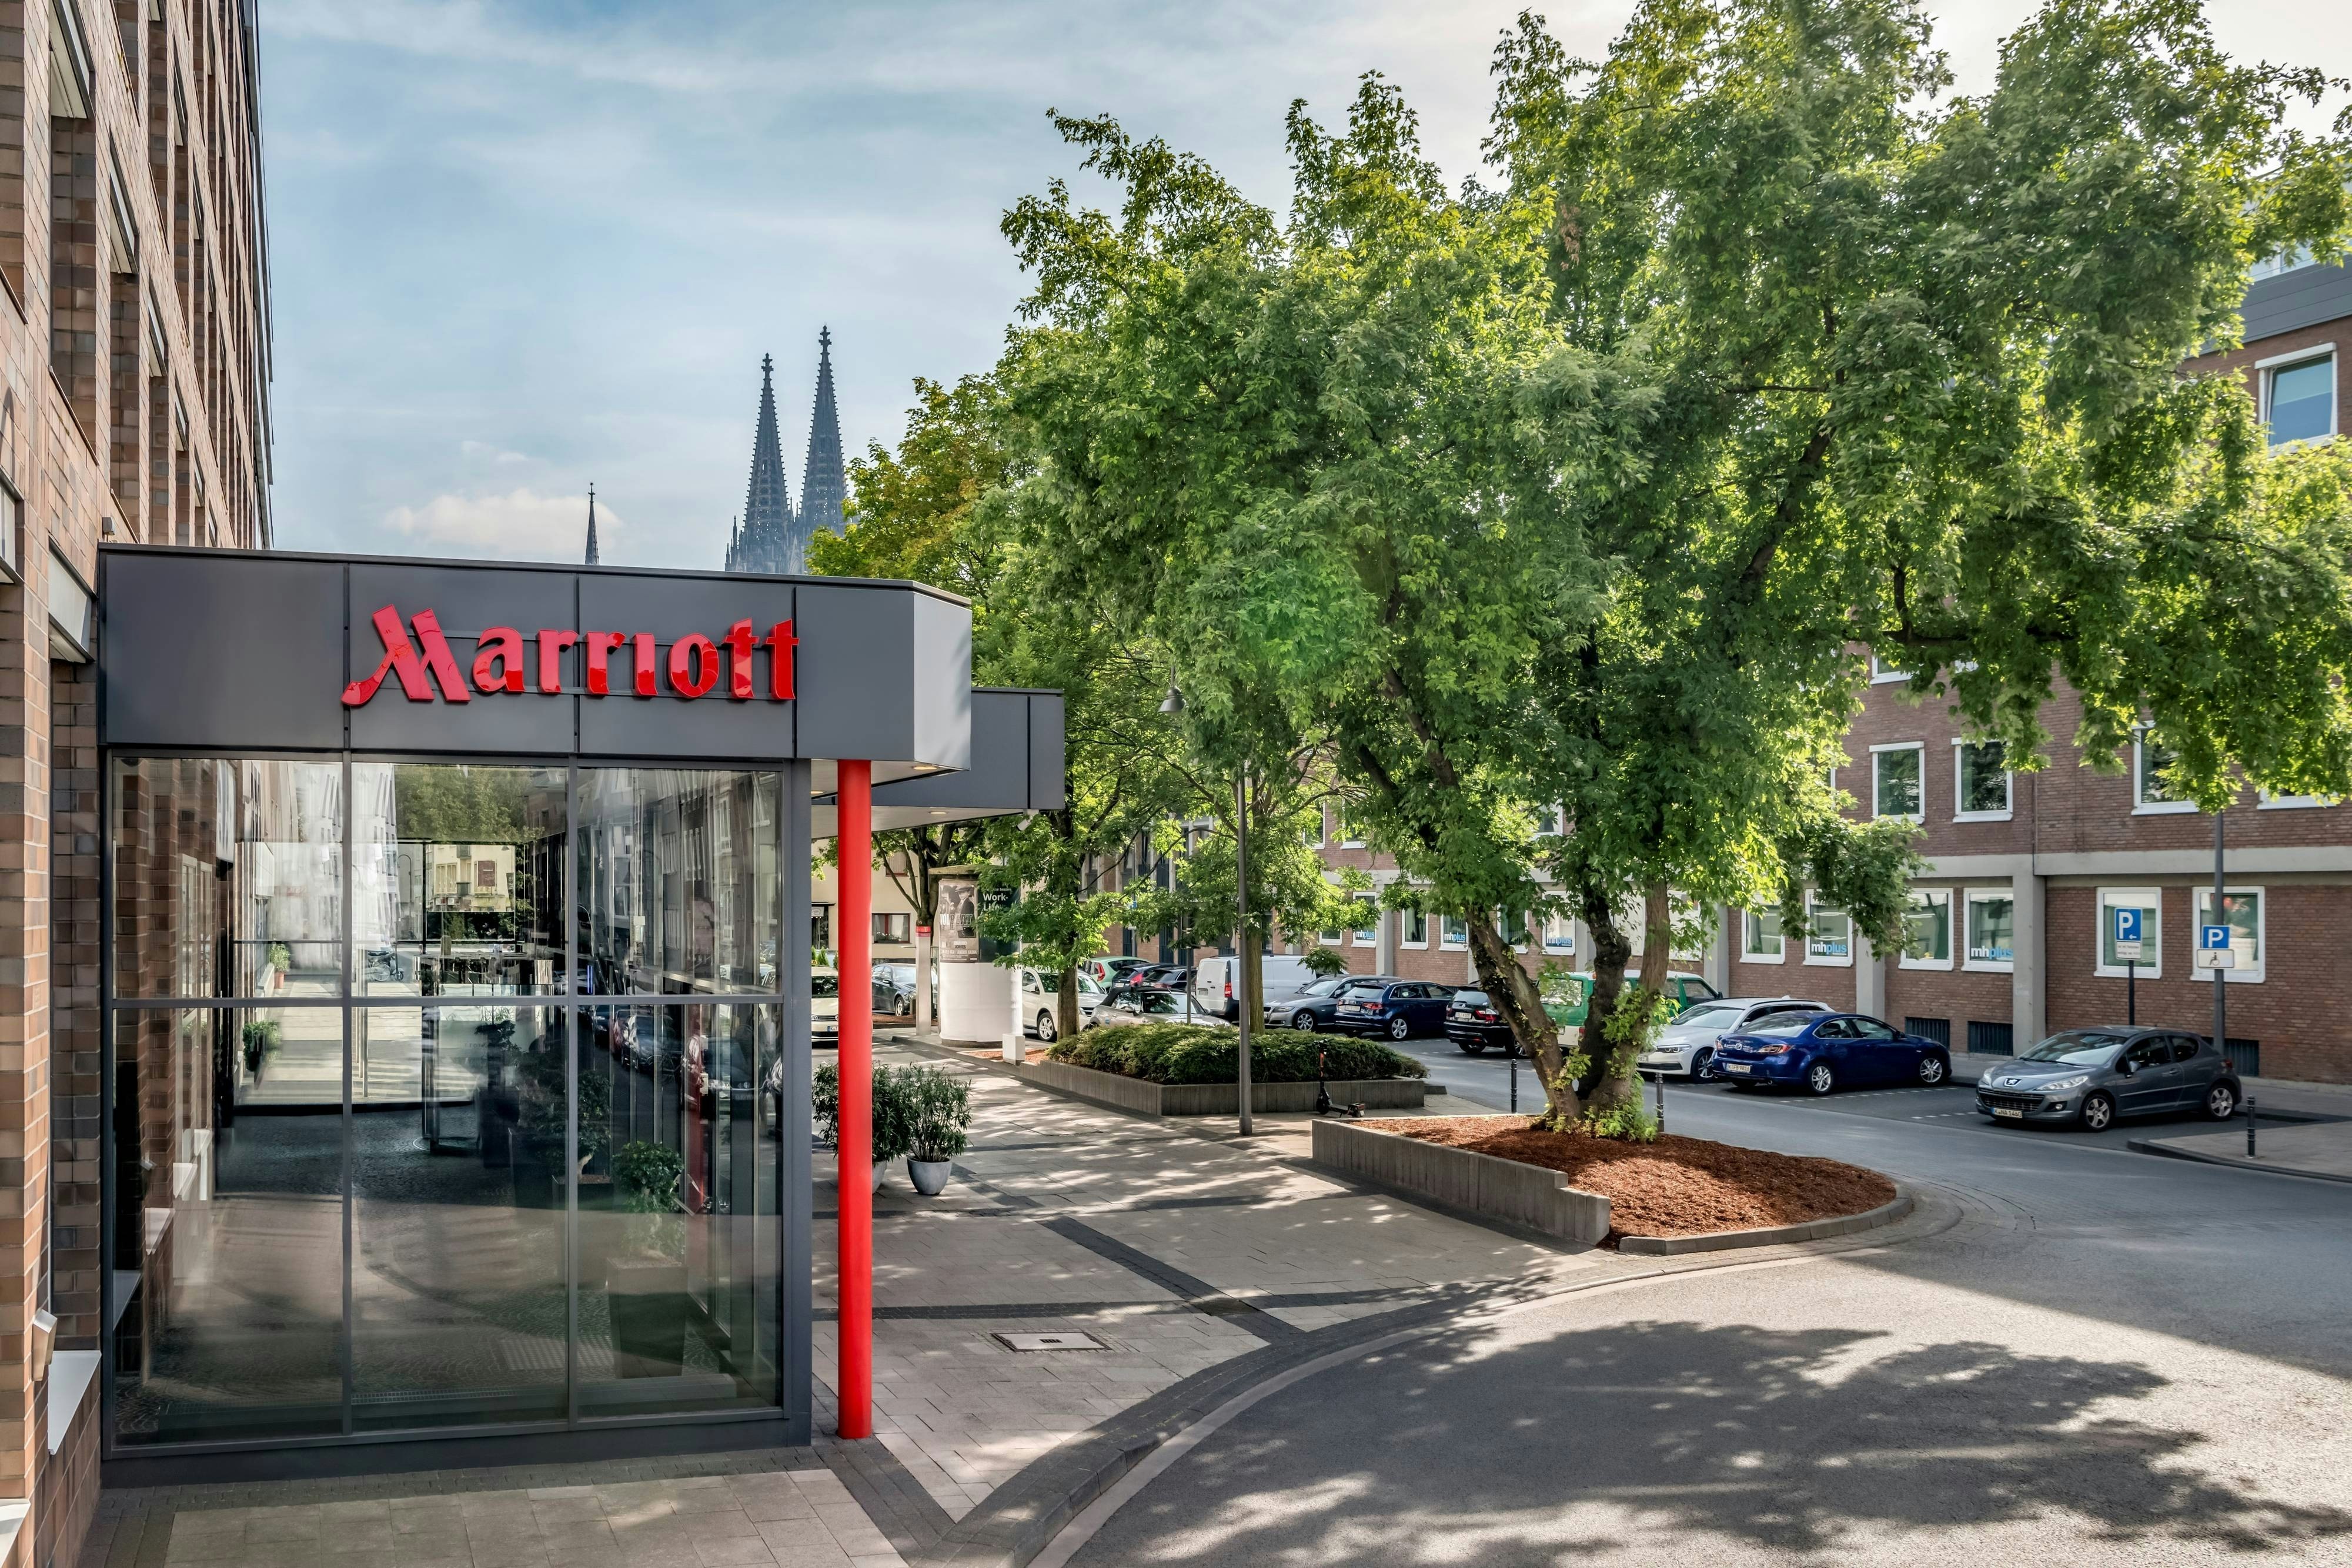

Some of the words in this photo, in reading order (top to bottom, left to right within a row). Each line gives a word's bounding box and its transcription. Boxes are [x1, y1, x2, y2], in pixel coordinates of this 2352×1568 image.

[341, 604, 800, 708] Marriott
[983, 893, 1008, 901] Work-
[2119, 911, 2134, 940] P
[1356, 930, 1375, 940] mhplus
[1444, 932, 1466, 942] mhplus
[1546, 936, 1572, 946] mhplus
[2208, 928, 2224, 948] P
[1811, 941, 1847, 955] mhplus
[1970, 945, 2014, 959] mhplus
